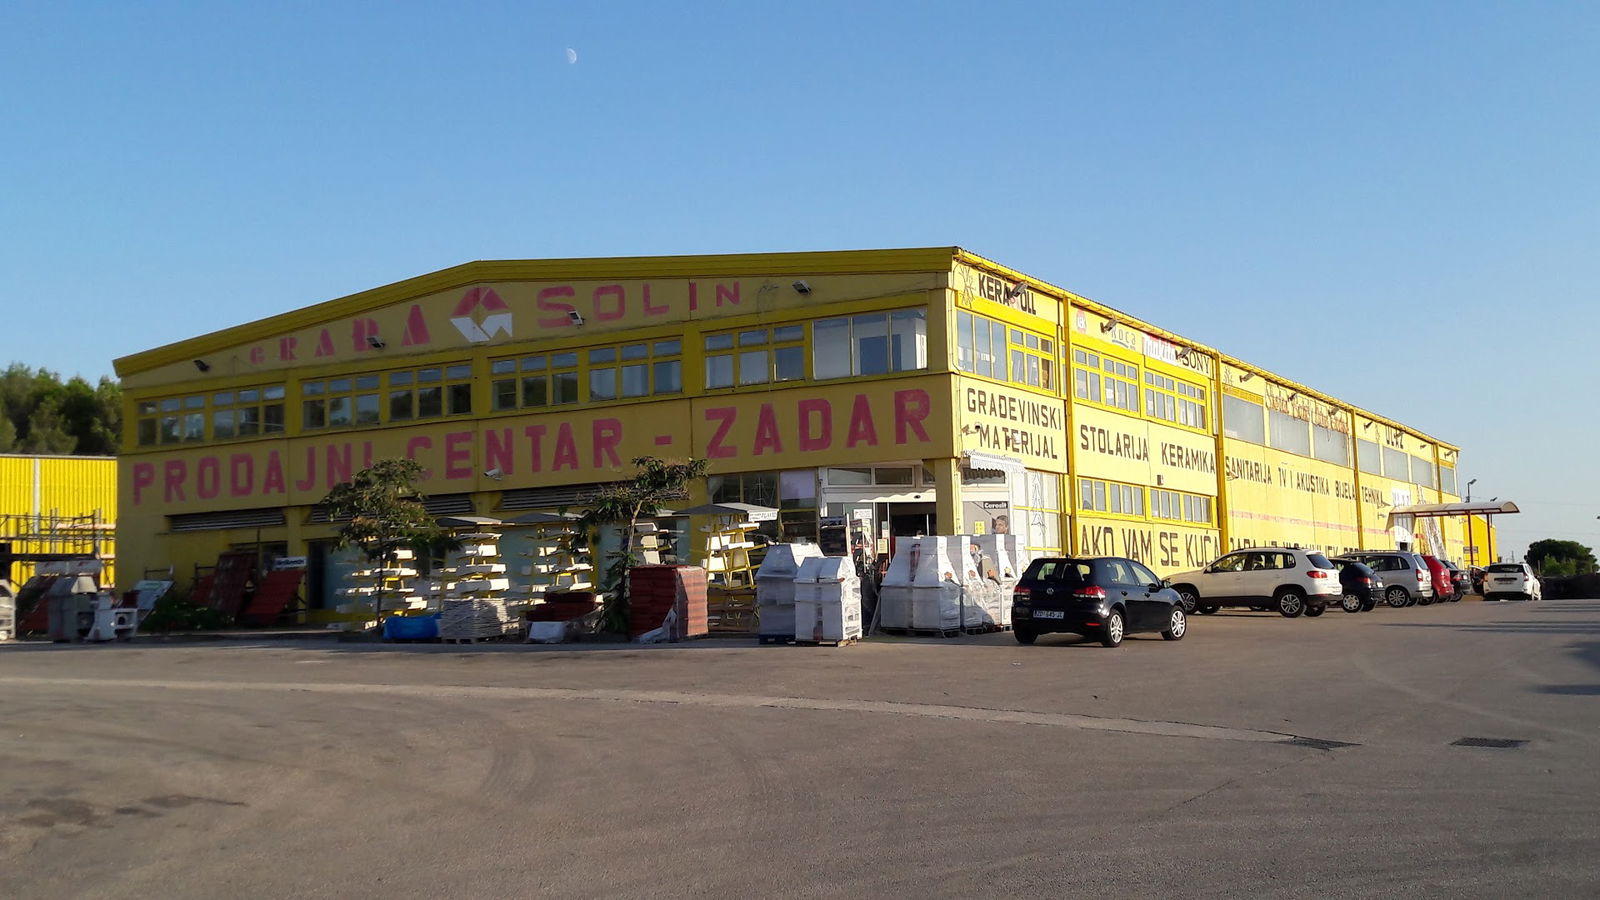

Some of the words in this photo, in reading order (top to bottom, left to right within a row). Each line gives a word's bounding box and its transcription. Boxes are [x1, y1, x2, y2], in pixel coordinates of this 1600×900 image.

[536, 281, 741, 329] SOLIN
[978, 273, 1036, 315] KERAOLL
[1182, 350, 1210, 374] SONY
[133, 441, 373, 505] PRODAJNI
[406, 418, 623, 482] CENTAR
[705, 388, 931, 459] ZADAR
[980, 423, 1058, 459] MATERIJAL
[1080, 424, 1150, 462] STOLARIJA
[1161, 442, 1216, 474] KERAMIKA
[1225, 456, 1273, 484] SANITARIJA
[1296, 472, 1330, 495] AKUSTIKA
[1335, 480, 1356, 500] BIJELA
[1081, 525, 1115, 556] AKO
[1122, 528, 1153, 565] VAM
[1160, 532, 1180, 567] SE
